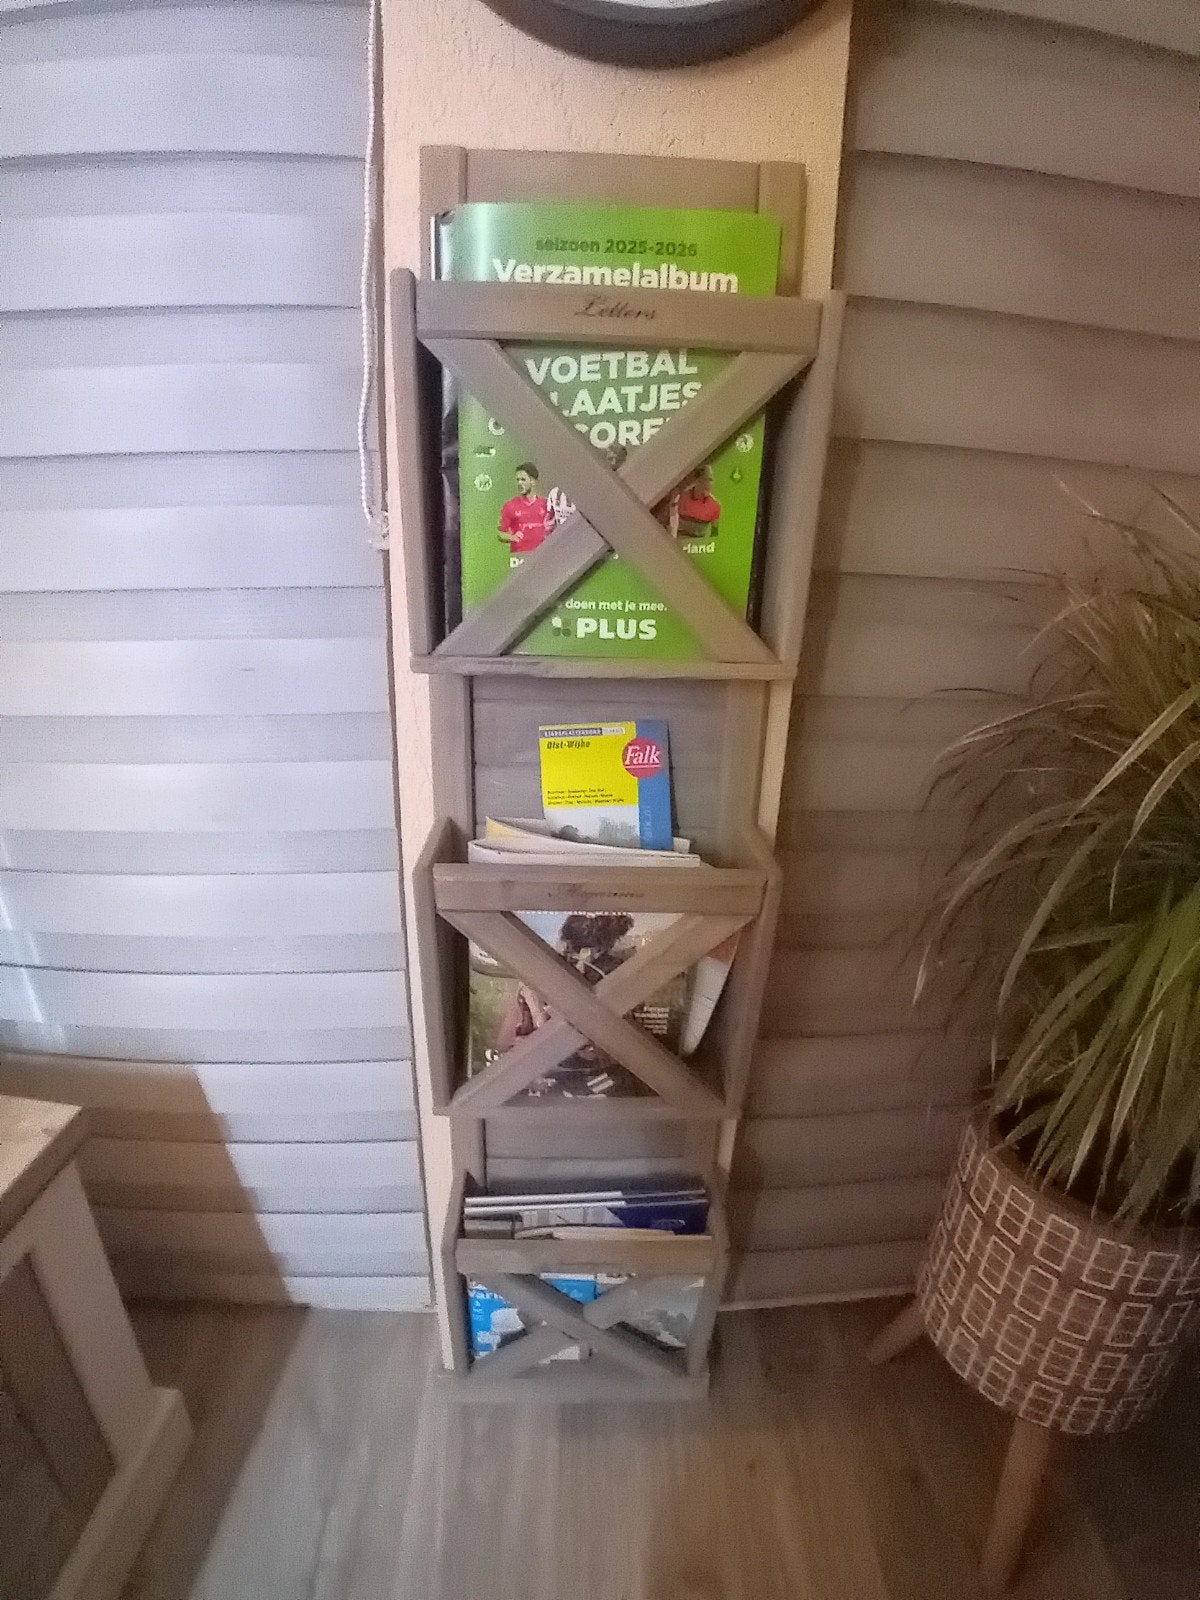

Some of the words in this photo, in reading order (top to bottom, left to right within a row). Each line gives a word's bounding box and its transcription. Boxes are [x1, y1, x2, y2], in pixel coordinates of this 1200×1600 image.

[535, 237, 600, 253] seizoen
[603, 239, 698, 258] 2025-2026
[493, 258, 739, 293] Verzamelalbum
[574, 295, 656, 321] Letters
[525, 348, 698, 386] VOETBAL
[682, 541, 716, 554] land
[565, 598, 596, 610] doen
[599, 600, 623, 611] met
[624, 600, 636, 612] je
[638, 601, 668, 612] mee.
[576, 617, 658, 640] PLUS
[624, 744, 662, 766] Falk
